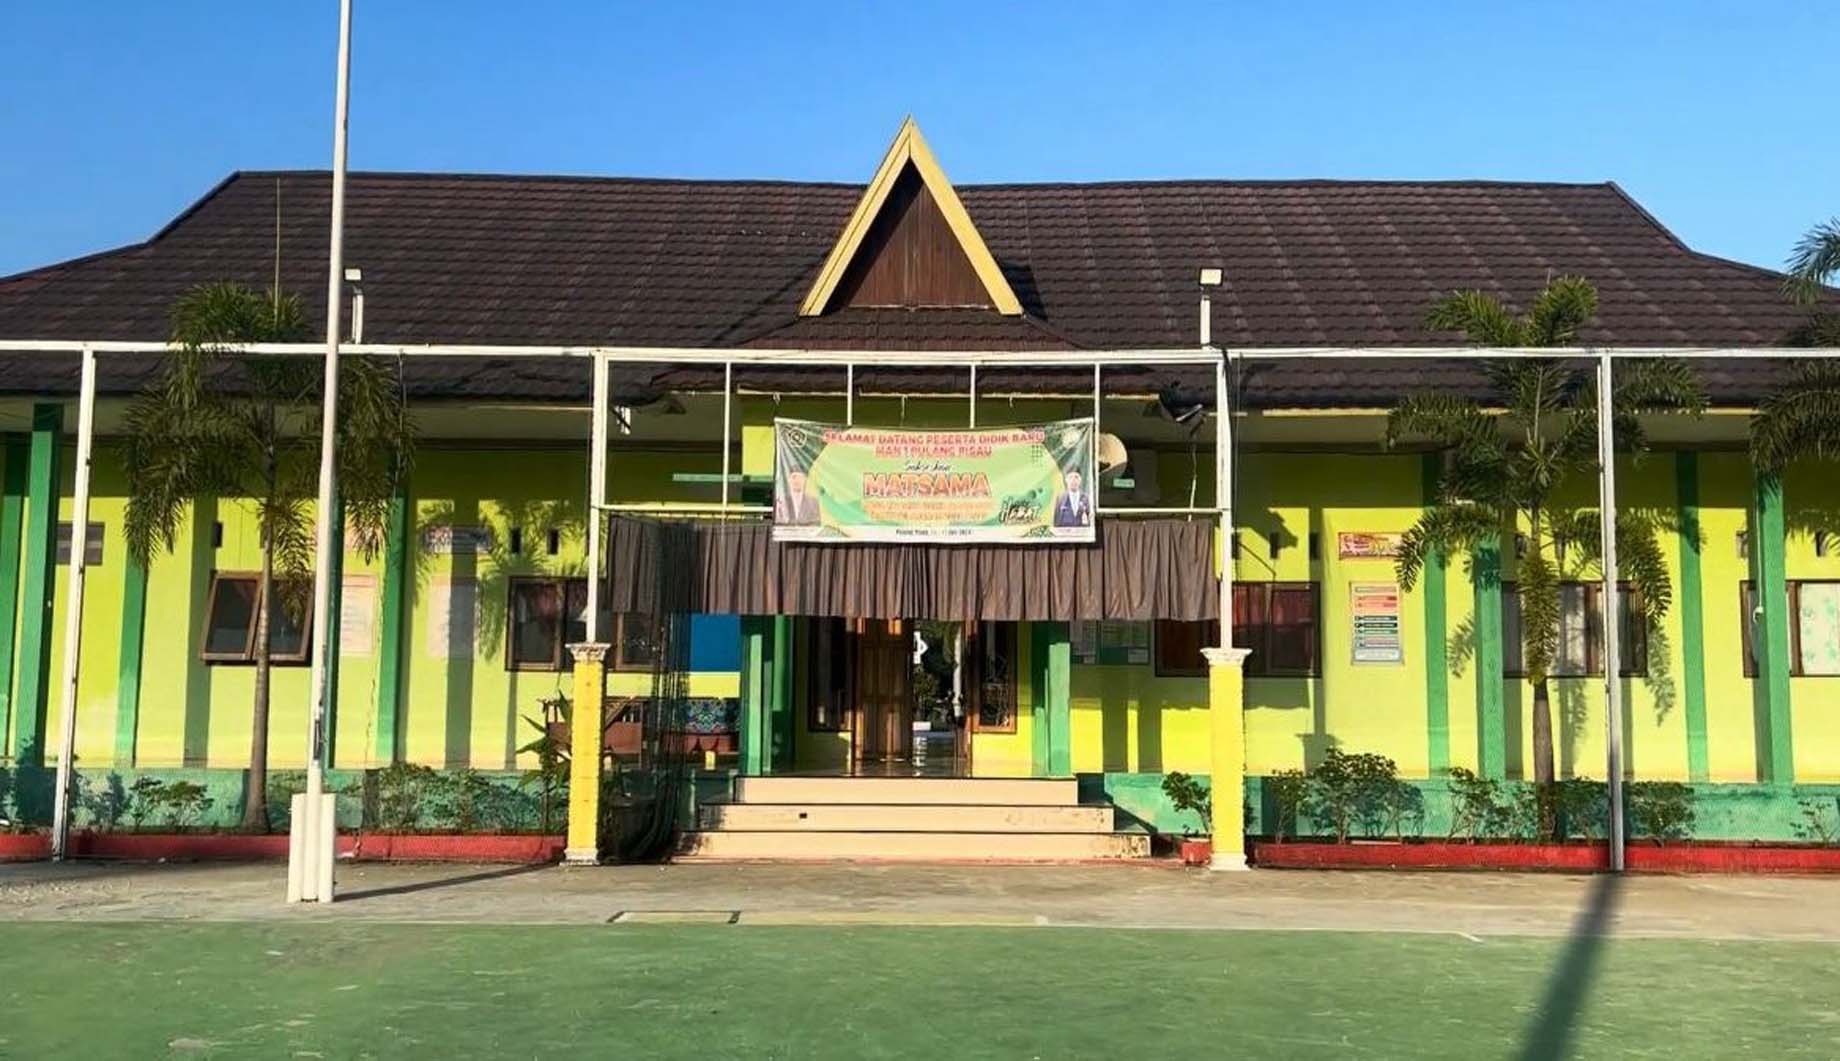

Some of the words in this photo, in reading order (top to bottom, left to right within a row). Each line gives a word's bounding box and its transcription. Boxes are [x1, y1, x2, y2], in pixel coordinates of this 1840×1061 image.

[823, 430, 875, 443] SELAMAT
[878, 433, 925, 445] DATANG
[926, 433, 976, 444] PESERTA
[979, 433, 1009, 444] DIDIK
[1012, 430, 1044, 443] BARU
[875, 445, 902, 456] MAN
[911, 445, 955, 456] PULANG
[958, 445, 991, 457] PISAU
[863, 472, 992, 497] MATSAMA
